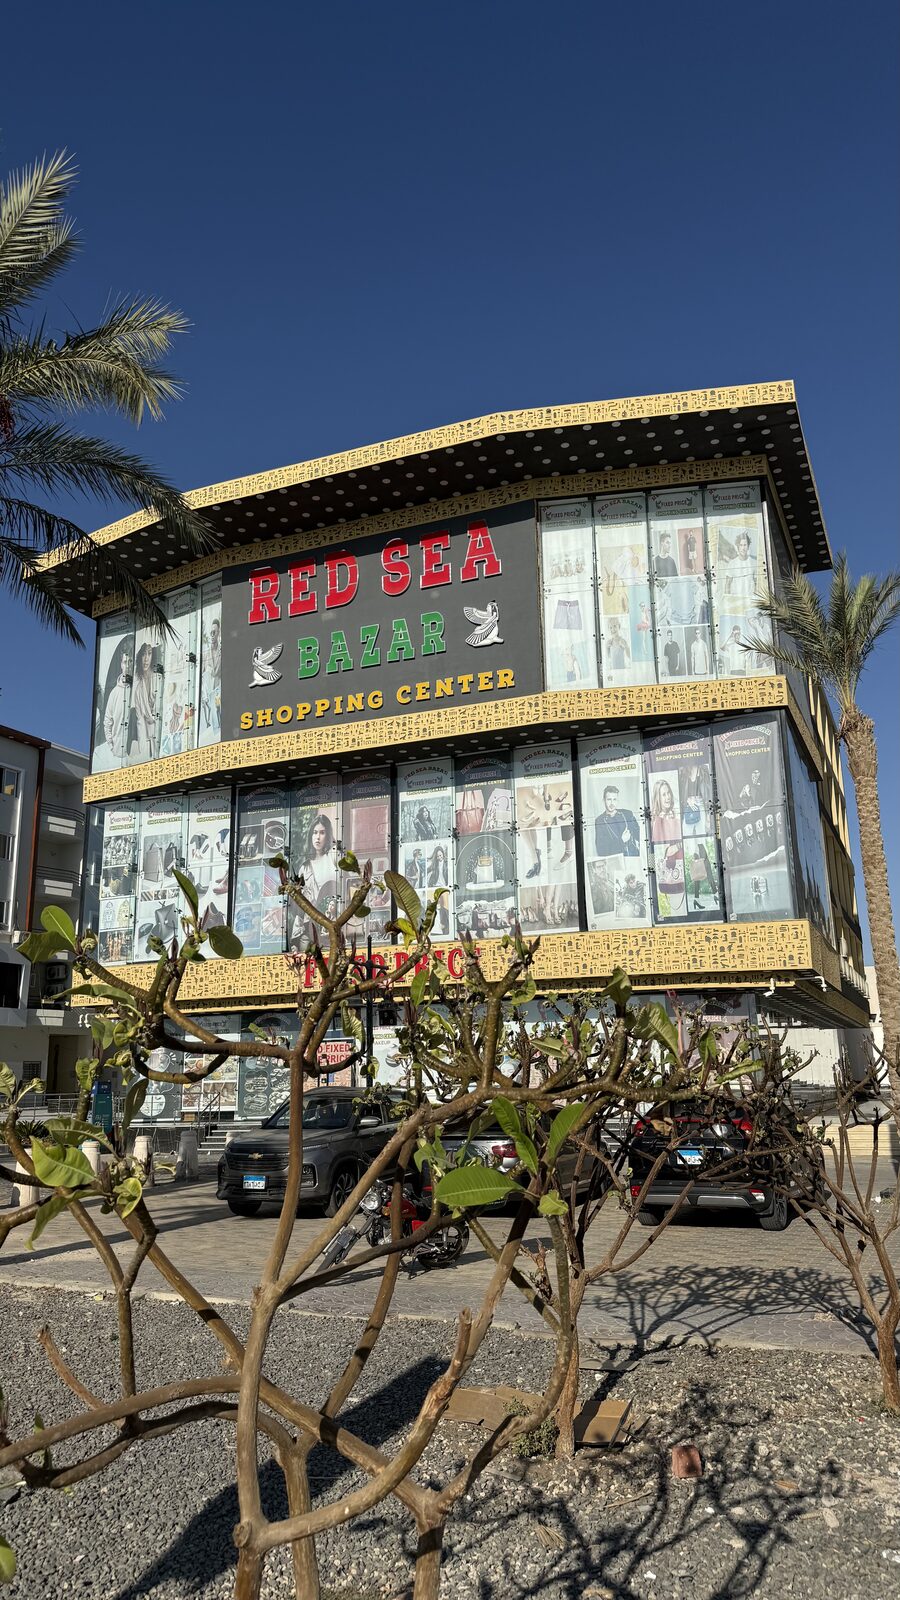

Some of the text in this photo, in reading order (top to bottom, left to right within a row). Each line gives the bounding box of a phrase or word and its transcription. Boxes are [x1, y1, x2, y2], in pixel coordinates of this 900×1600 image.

[248, 519, 502, 624] RED SEA
[297, 611, 446, 679] BAZAR
[240, 669, 516, 730] SHOPPING CENTER
[520, 749, 569, 764] RED SEA BAZAR
[585, 748, 600, 759] RED
[612, 743, 637, 753] BAZAR
[656, 753, 682, 761] SHOPPING
[403, 771, 416, 781] RED
[325, 1044, 351, 1053] FIXED
